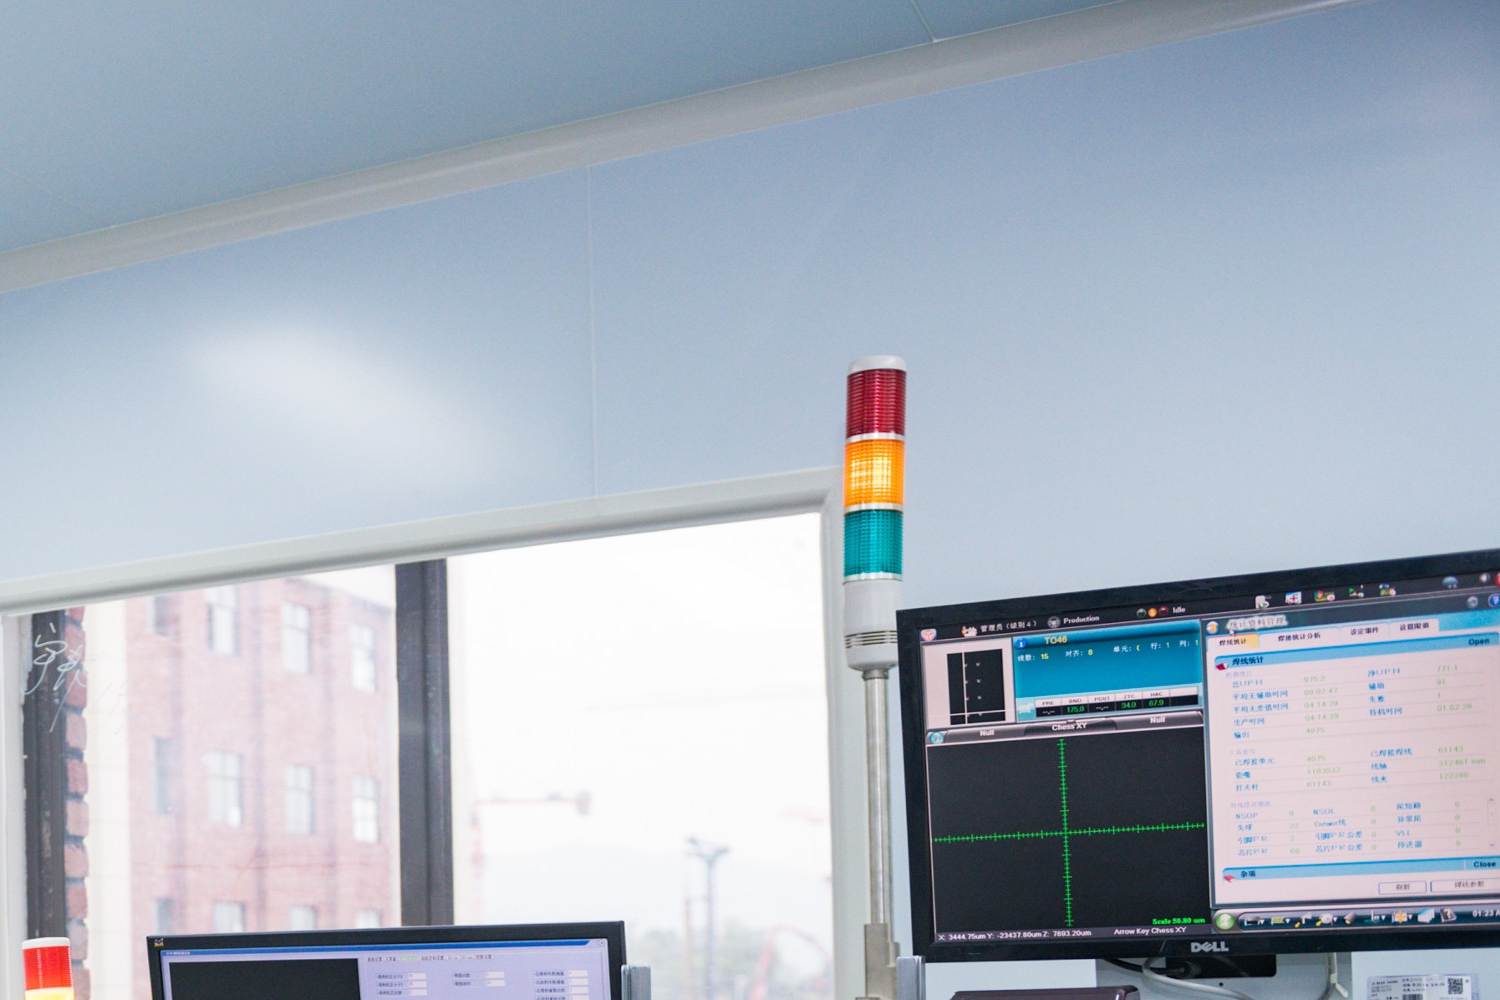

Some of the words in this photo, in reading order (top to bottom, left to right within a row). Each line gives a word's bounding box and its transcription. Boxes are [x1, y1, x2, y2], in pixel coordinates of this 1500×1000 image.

[1172, 606, 1186, 614] Idle
[1063, 615, 1100, 625] Production
[1468, 638, 1490, 646] Open
[1149, 716, 1166, 724] Null
[1051, 723, 1075, 731] Chess
[980, 729, 995, 737] Null
[1136, 928, 1149, 936] Key
[1191, 941, 1229, 952] DELL
